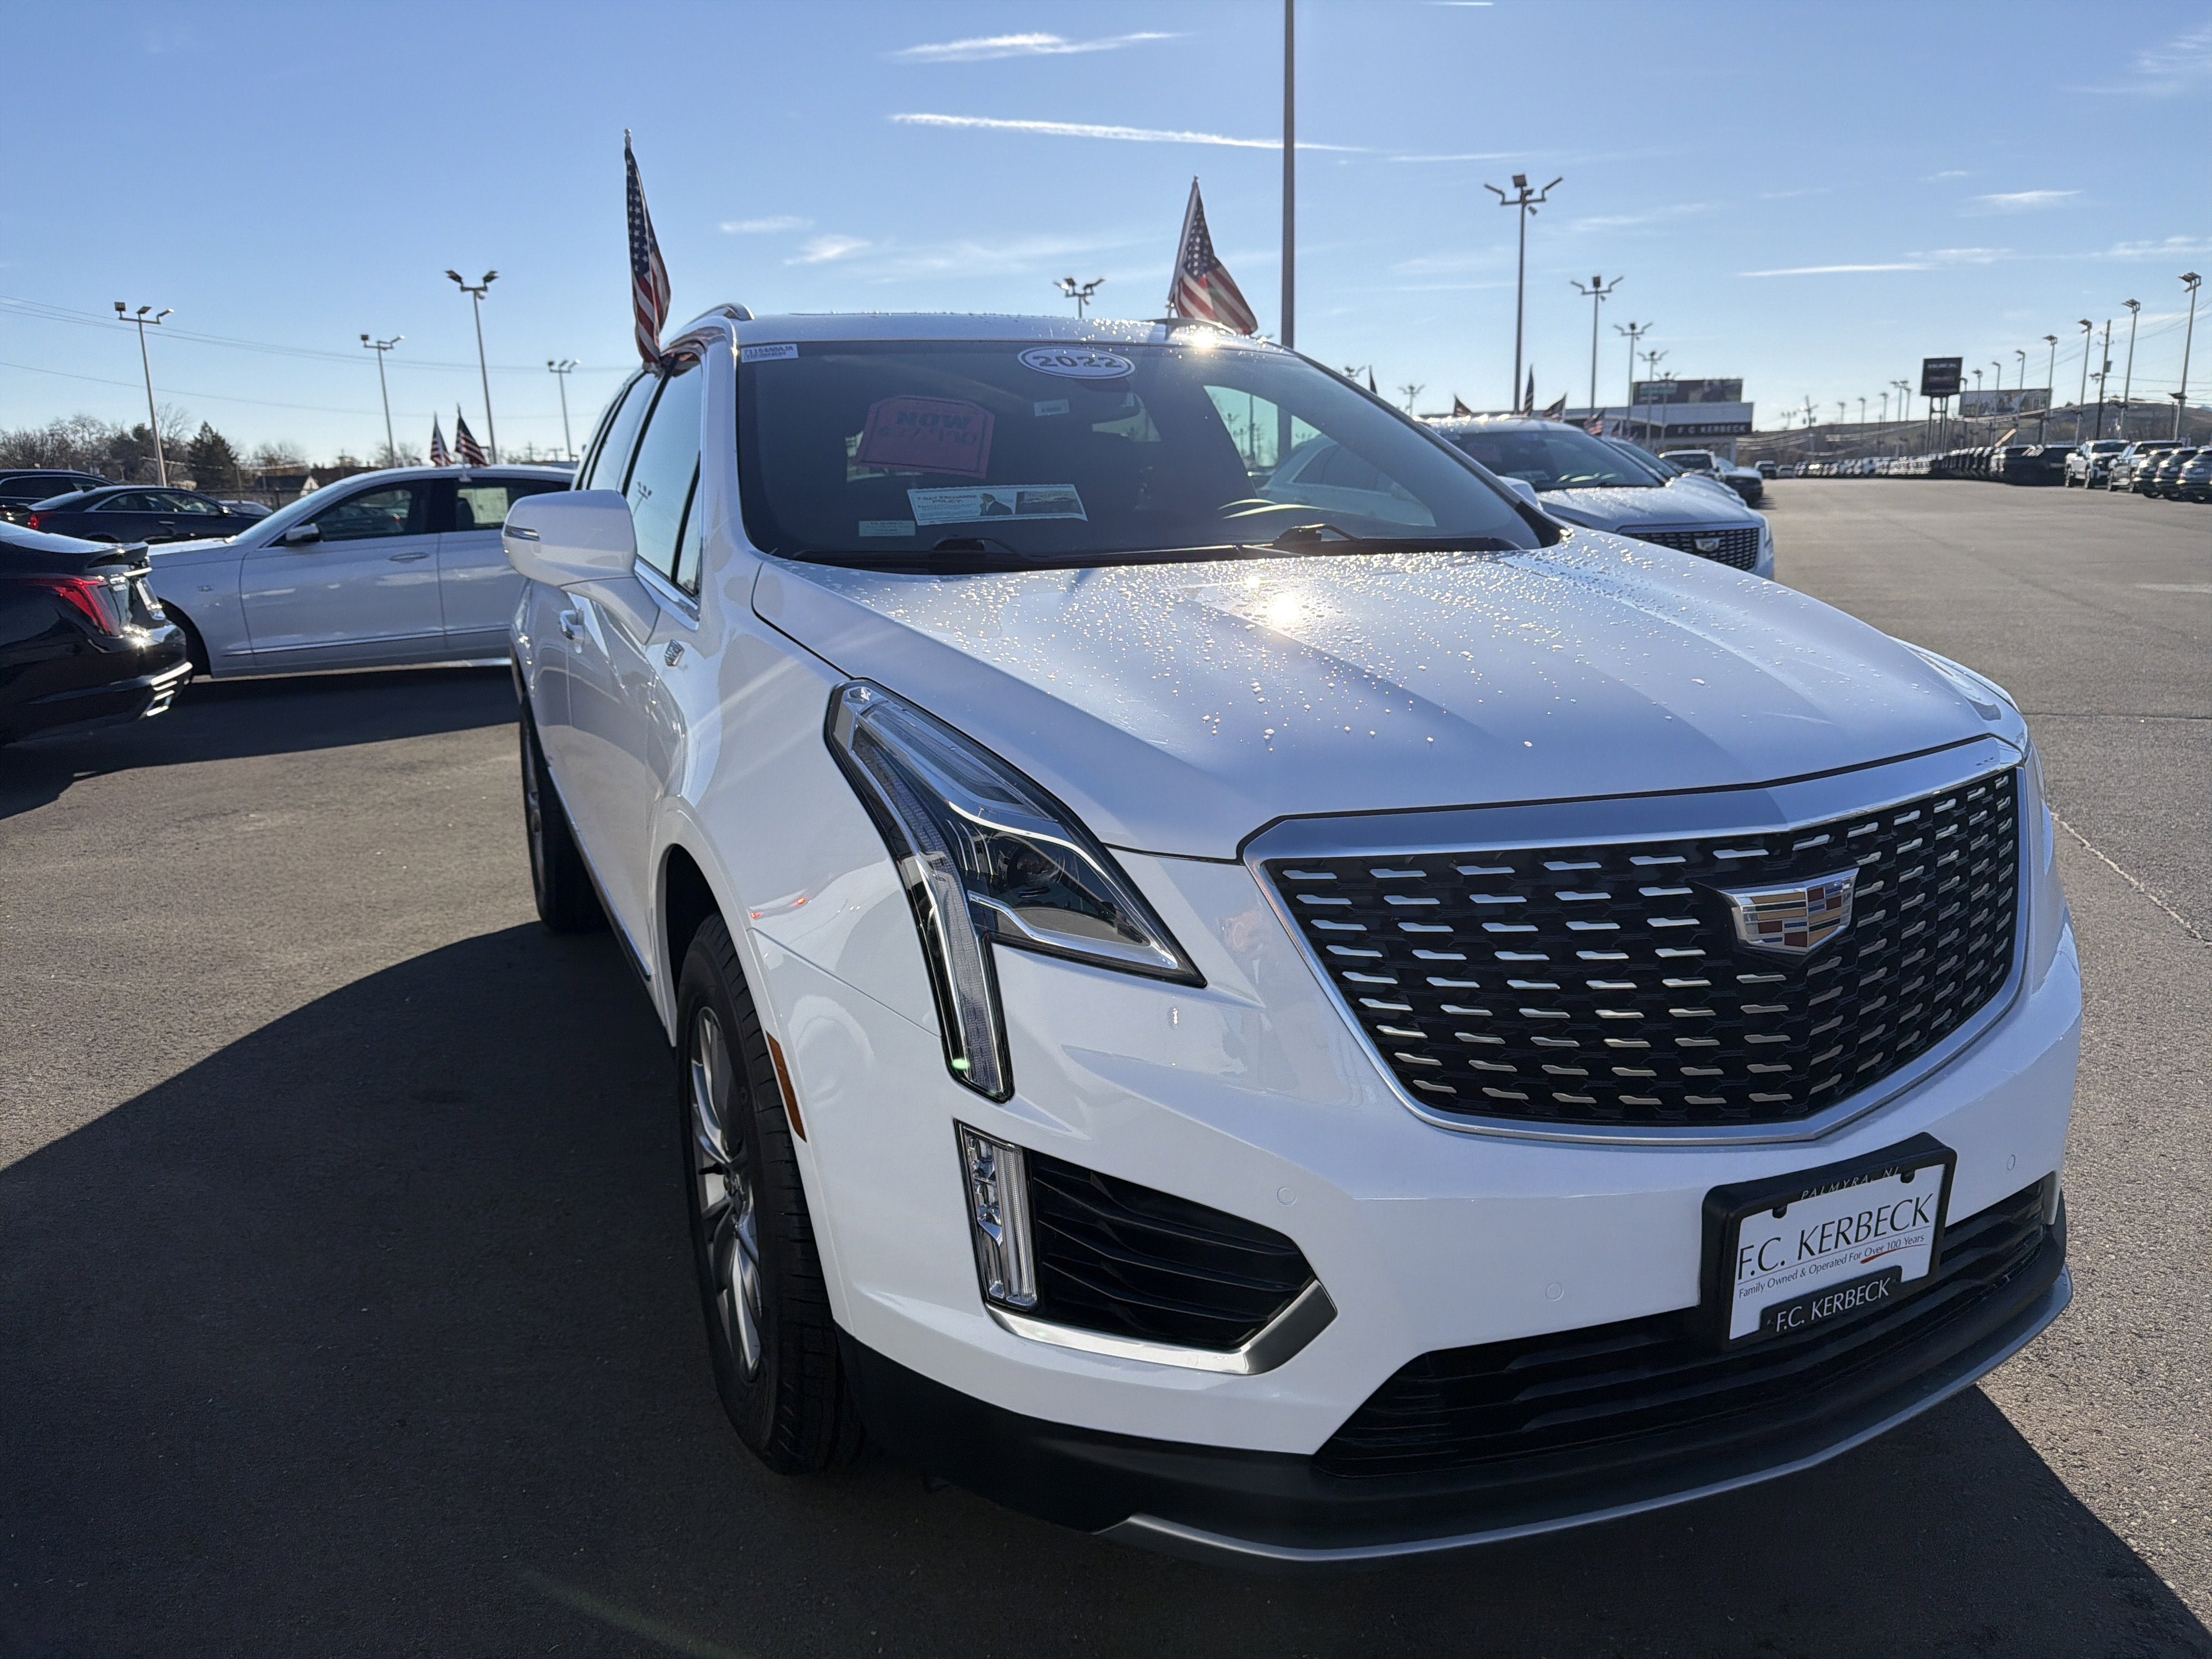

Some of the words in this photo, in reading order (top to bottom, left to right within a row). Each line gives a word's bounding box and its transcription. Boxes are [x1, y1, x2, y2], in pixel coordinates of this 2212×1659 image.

[1032, 356, 1122, 368] 2022
[1737, 1237, 1785, 1280] F.C.
[1797, 1193, 1934, 1261] KERBECK
[1739, 1282, 1765, 1299] Family
[1767, 1269, 1798, 1288] Owned
[1799, 1268, 1807, 1278] &
[1809, 1254, 1848, 1274] Operated
[1848, 1253, 1862, 1262] For
[1864, 1245, 1884, 1257] Over
[1887, 1239, 1901, 1250] 100
[1904, 1234, 1925, 1245] Years
[1776, 1306, 1805, 1333] F.C.
[1811, 1277, 1891, 1321] KERBECK
